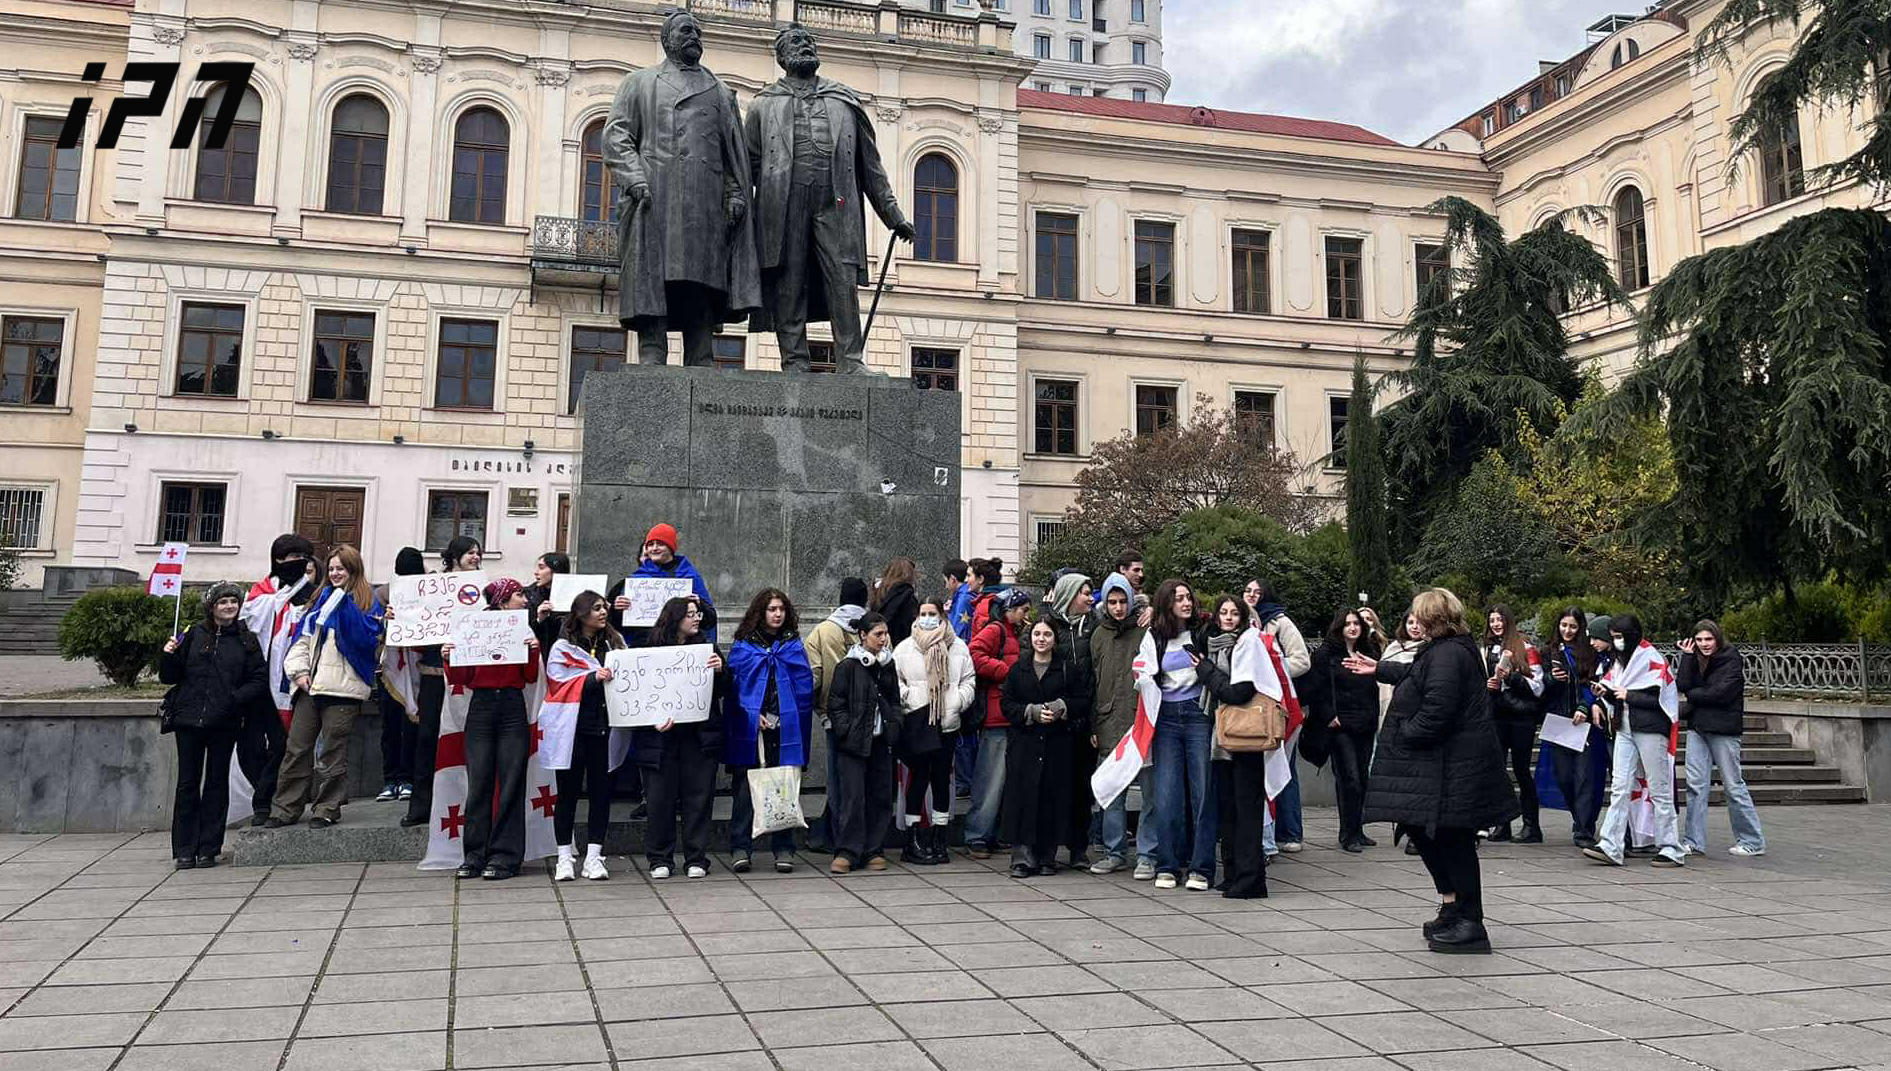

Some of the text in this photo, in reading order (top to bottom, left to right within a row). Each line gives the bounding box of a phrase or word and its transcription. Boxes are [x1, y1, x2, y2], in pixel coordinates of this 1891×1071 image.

[452, 459, 532, 474] თბილისის
[417, 575, 458, 597] ჩვენ
[613, 655, 650, 693] ჩვენ
